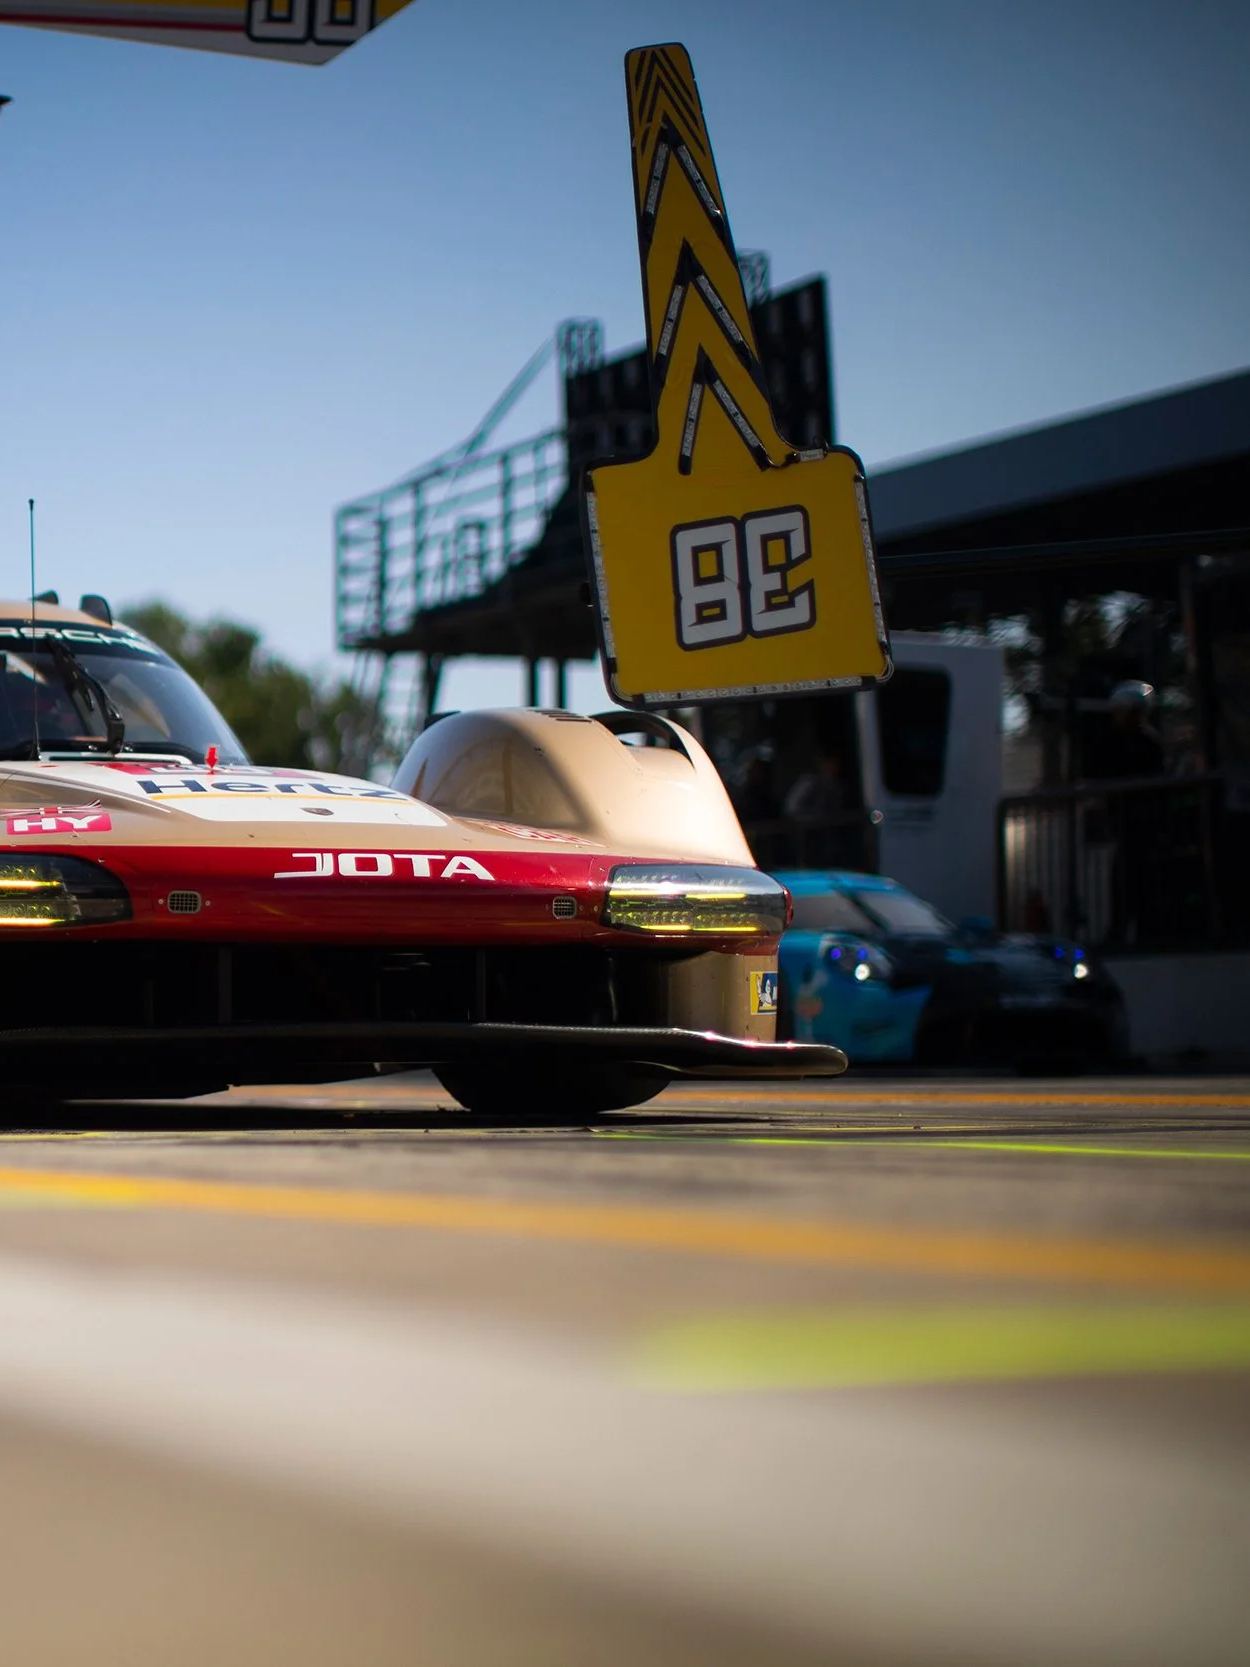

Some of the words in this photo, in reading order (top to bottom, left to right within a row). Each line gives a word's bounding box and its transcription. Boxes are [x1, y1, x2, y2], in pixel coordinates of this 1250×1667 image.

[670, 504, 816, 651] 38
[137, 779, 410, 801] Hertz
[12, 815, 104, 833] HY
[274, 852, 495, 881] JOTA
